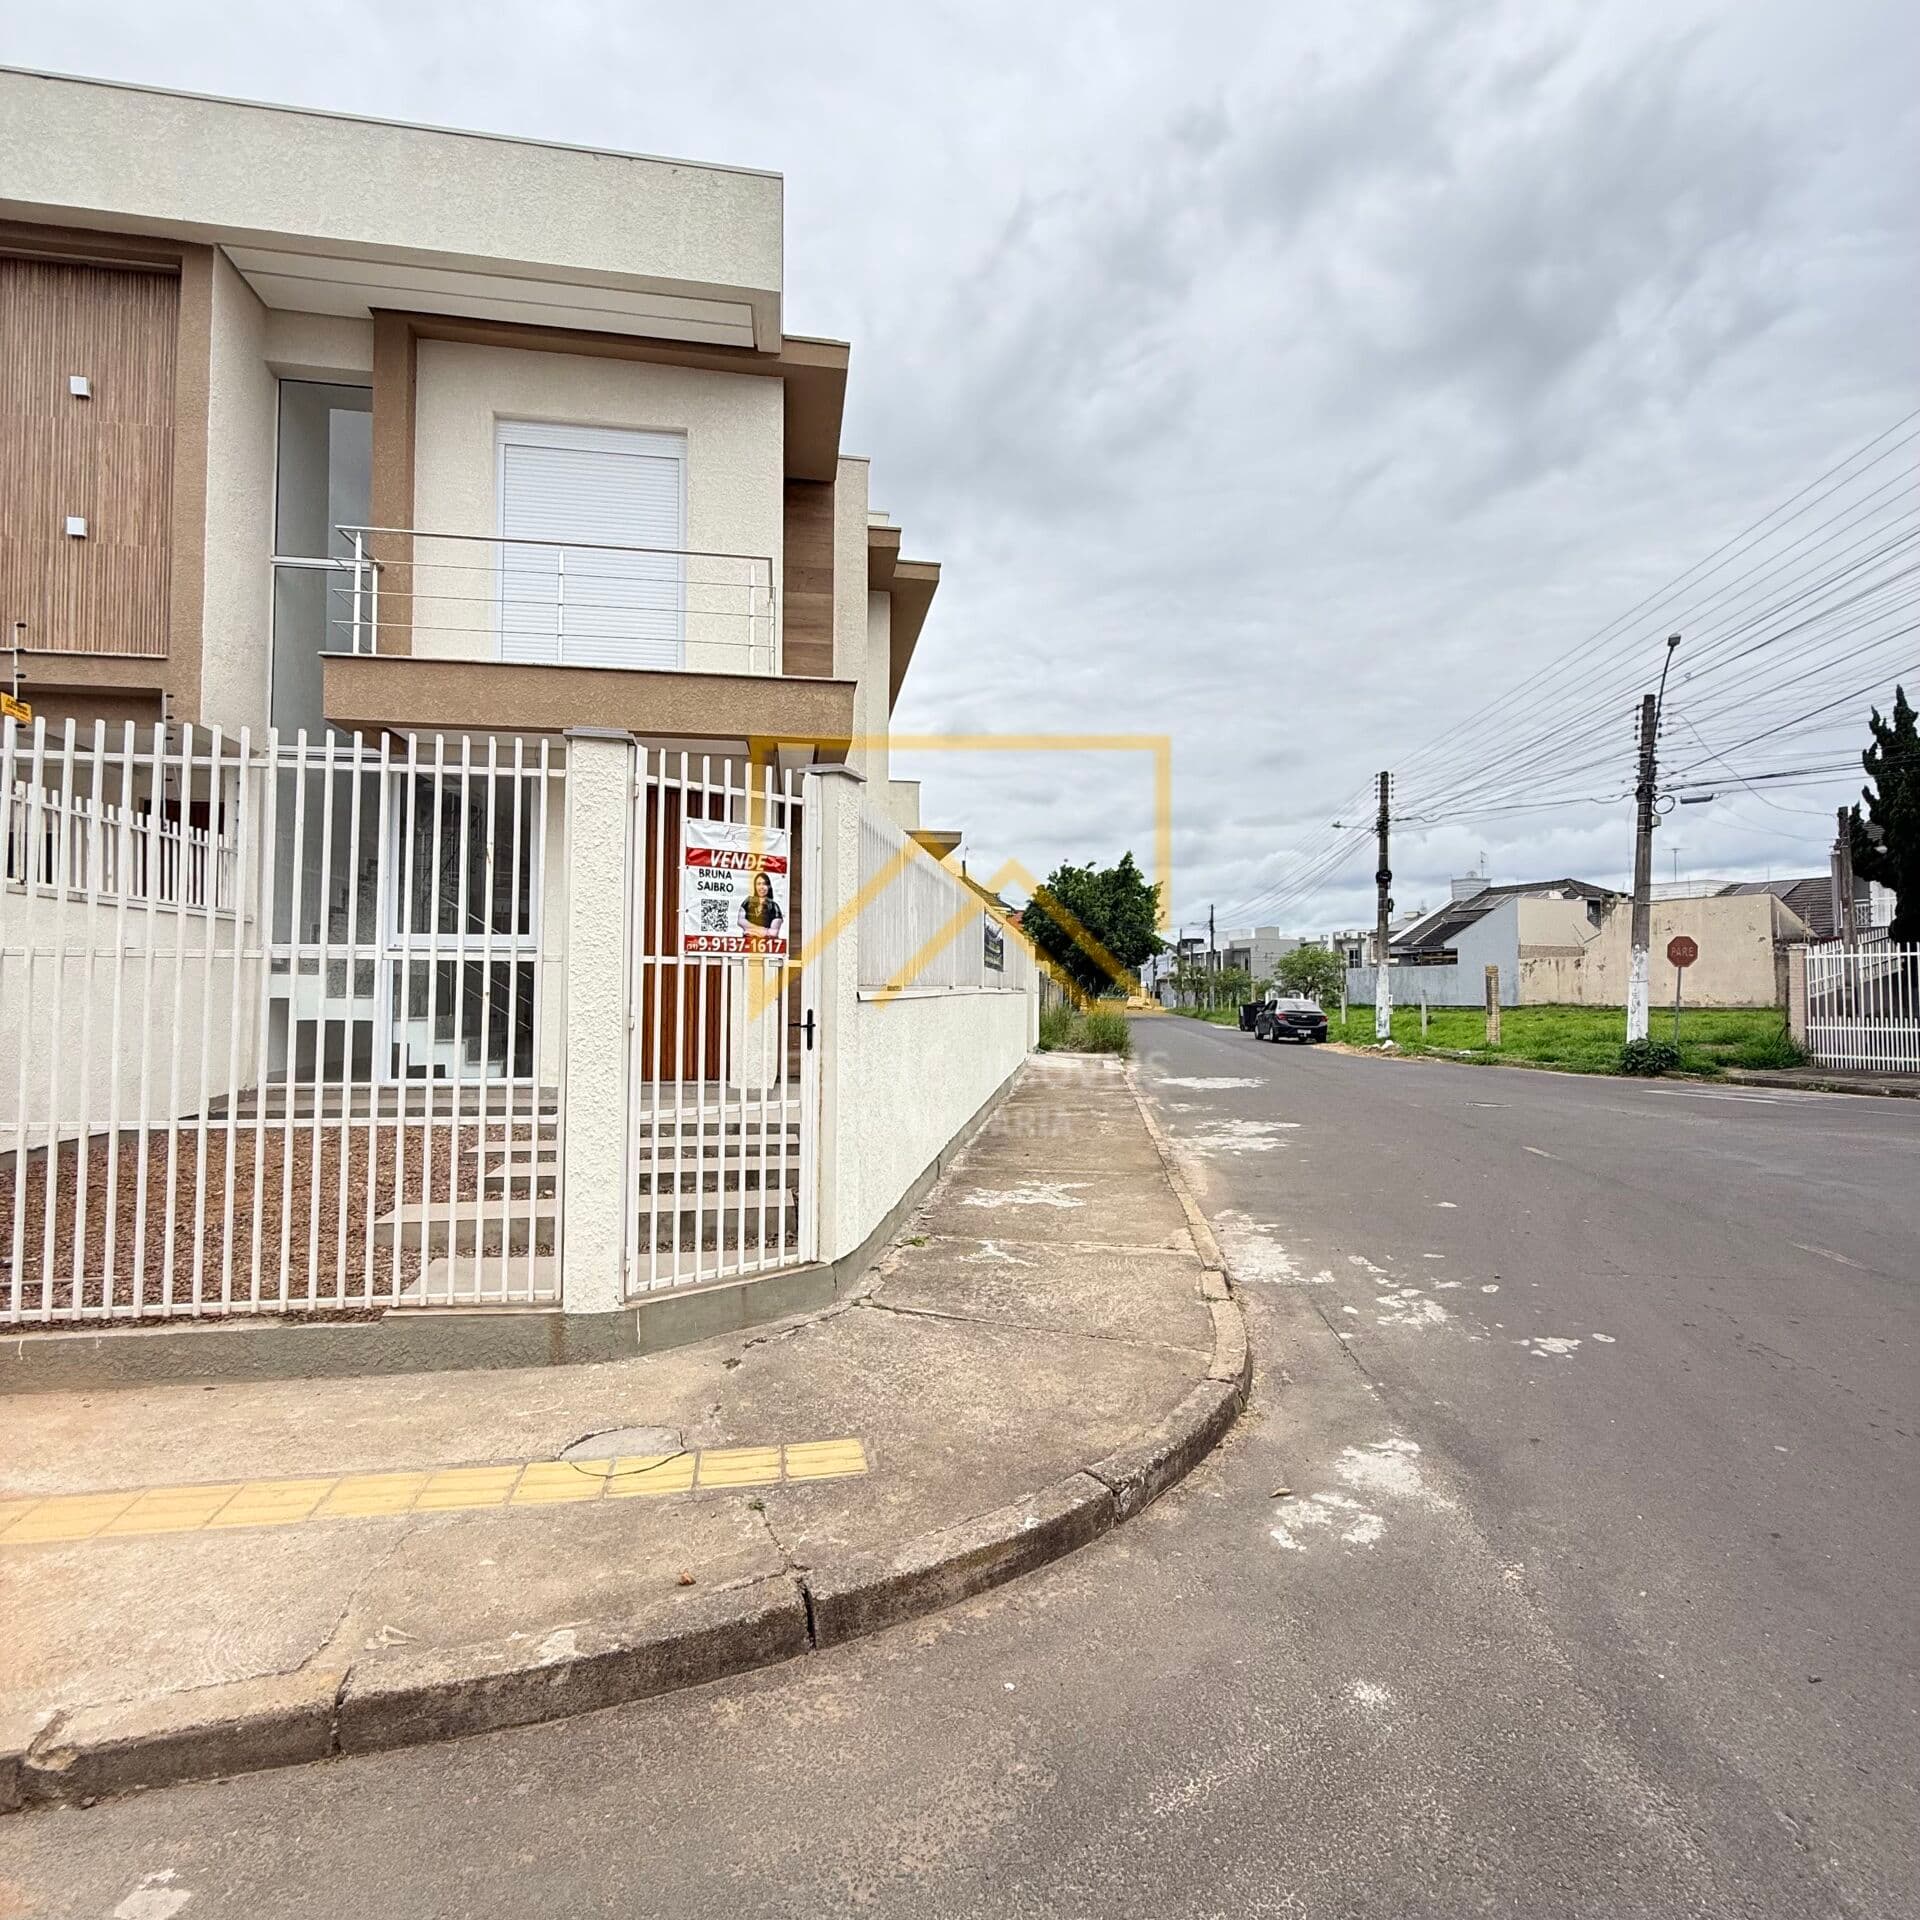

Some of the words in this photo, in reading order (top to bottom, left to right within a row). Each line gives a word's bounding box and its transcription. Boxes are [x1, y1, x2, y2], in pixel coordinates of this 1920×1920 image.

[710, 850, 768, 871] VENDE
[699, 868, 732, 880] BRUNA
[697, 881, 734, 893] SAIBRO
[698, 937, 782, 953] 9.9137-1617
[1671, 947, 1694, 957] PARE
